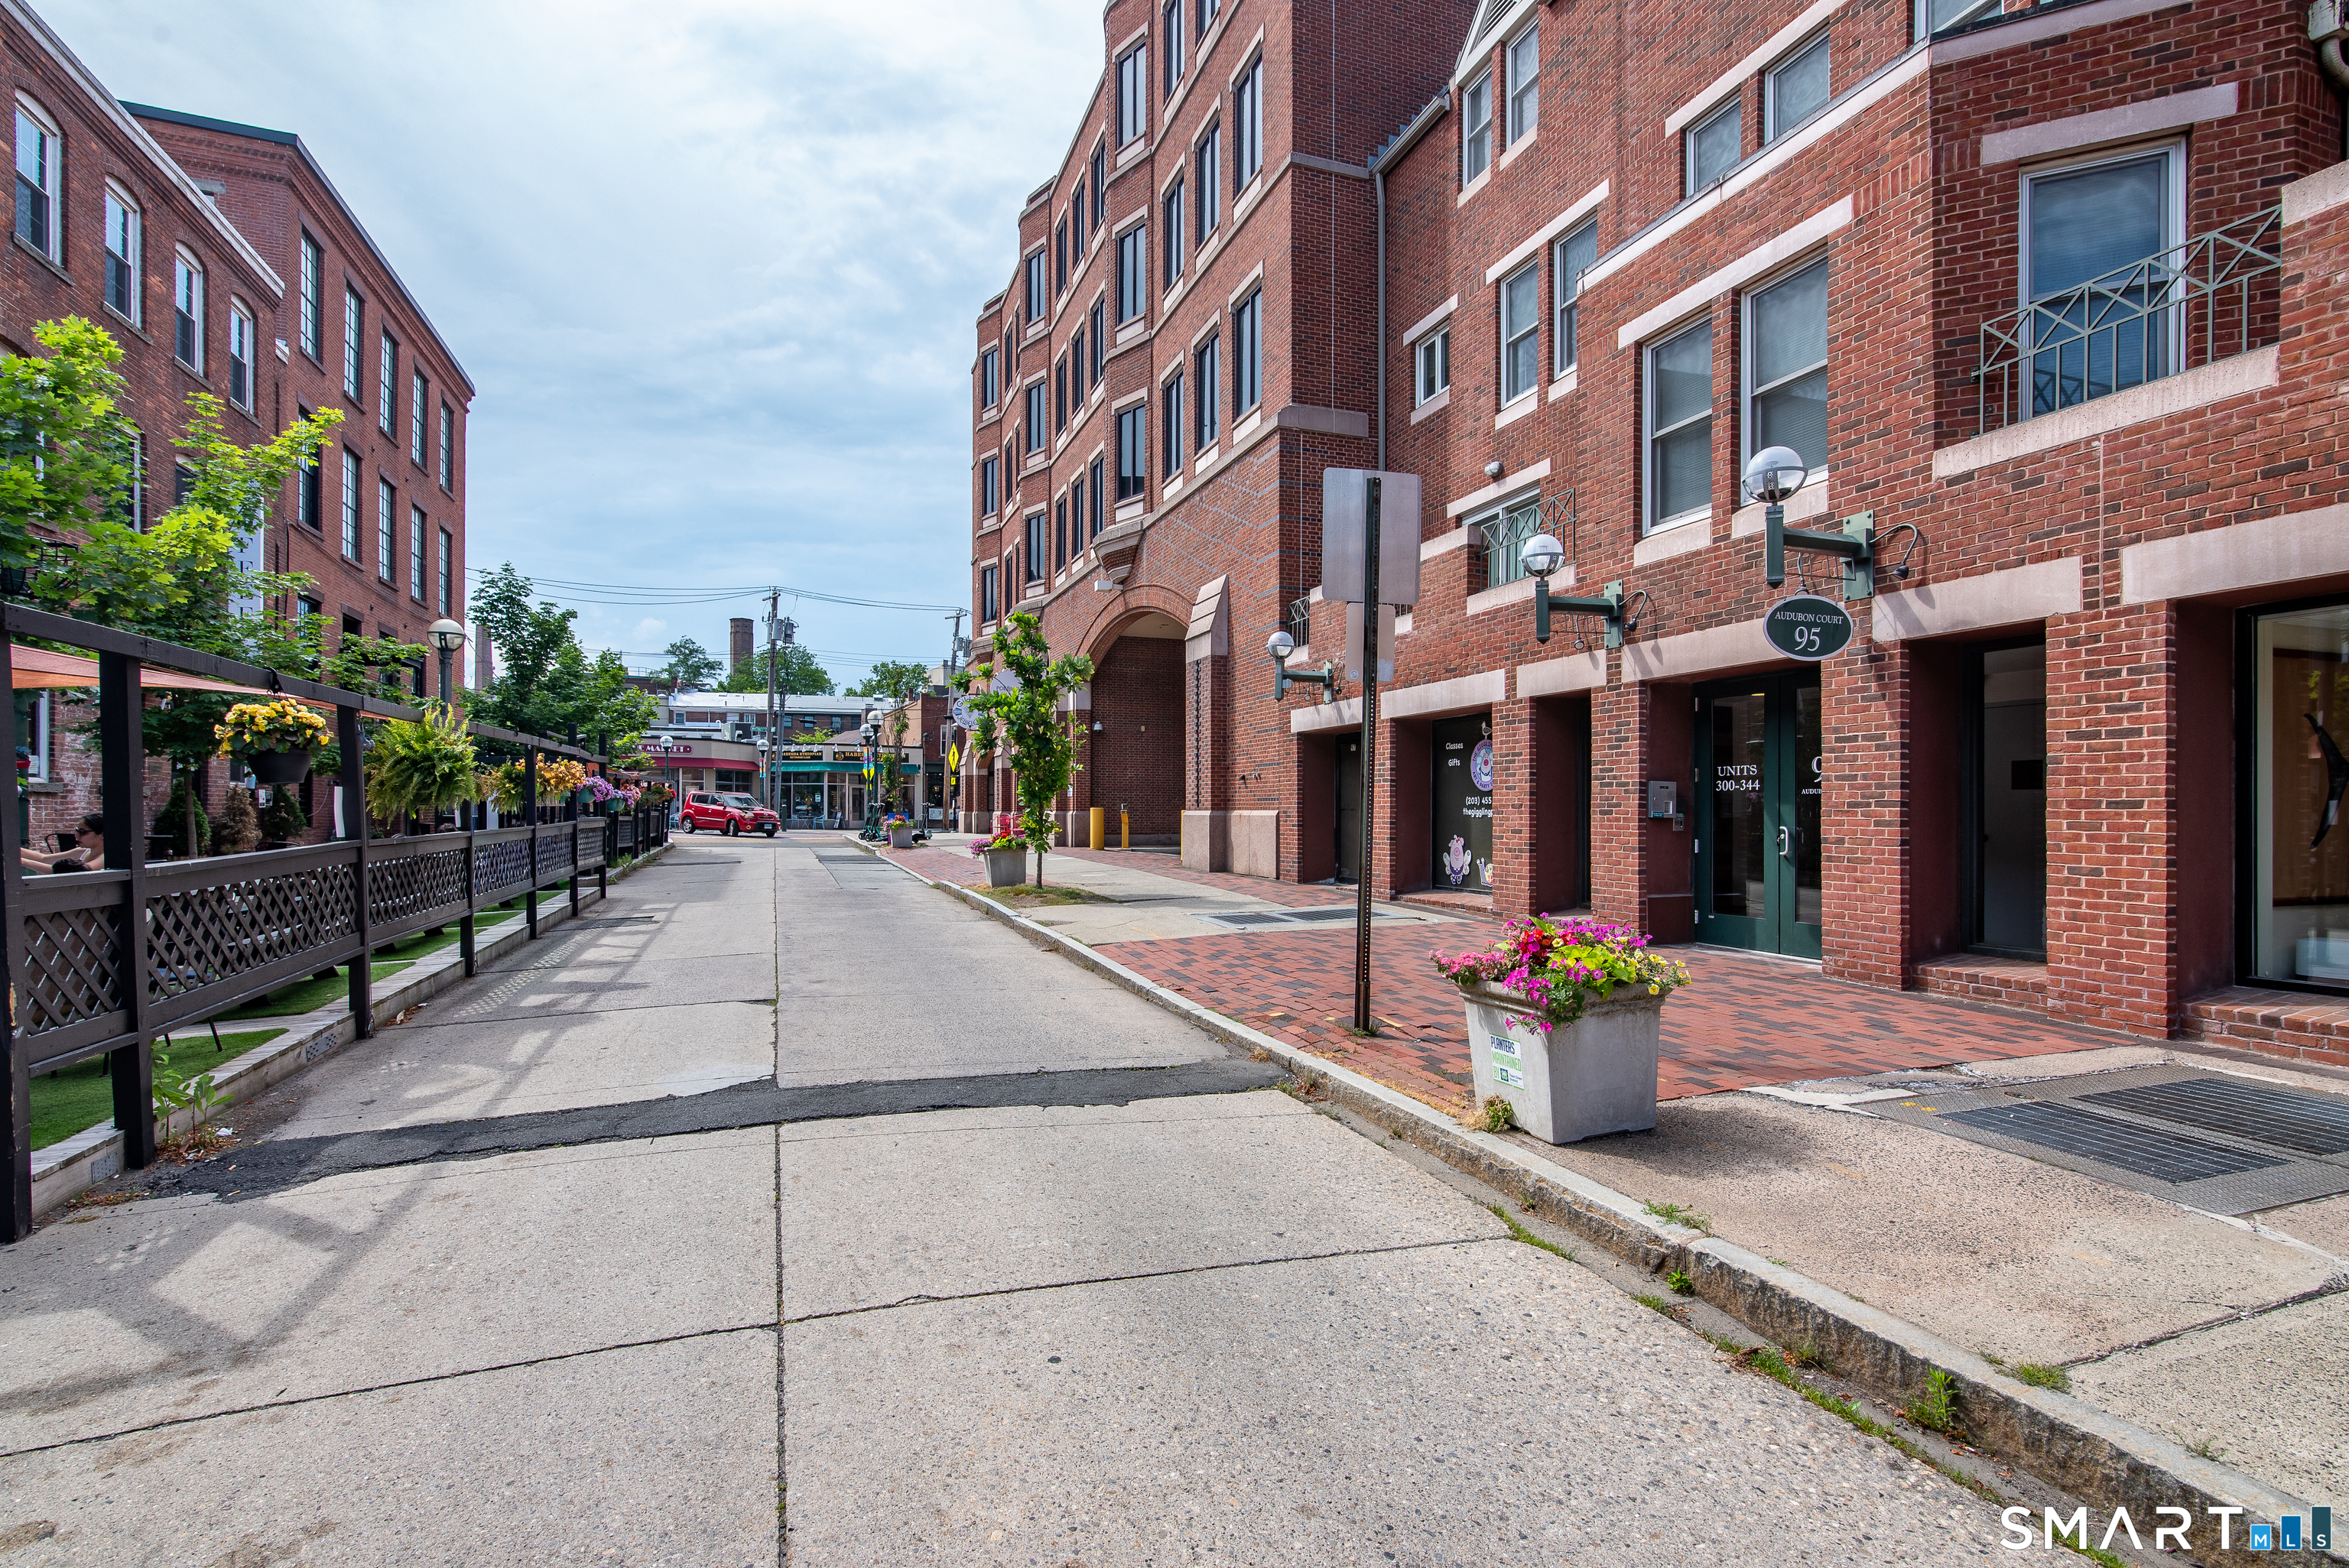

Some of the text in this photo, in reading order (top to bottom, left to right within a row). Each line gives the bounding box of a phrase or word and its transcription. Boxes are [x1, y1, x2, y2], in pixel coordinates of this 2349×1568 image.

[1775, 611, 1844, 625] AUDUBON COURT
[1794, 626, 1821, 651] 95
[1477, 742, 1493, 752] GIGGLIN
[1717, 765, 1758, 776] UNITS
[1716, 779, 1760, 791] 300-344
[1466, 796, 1480, 806] (203)
[1490, 1036, 1515, 1054] PLANTERS
[1492, 1050, 1522, 1072] MAINTAINED
[1493, 1065, 1499, 1079] BY
